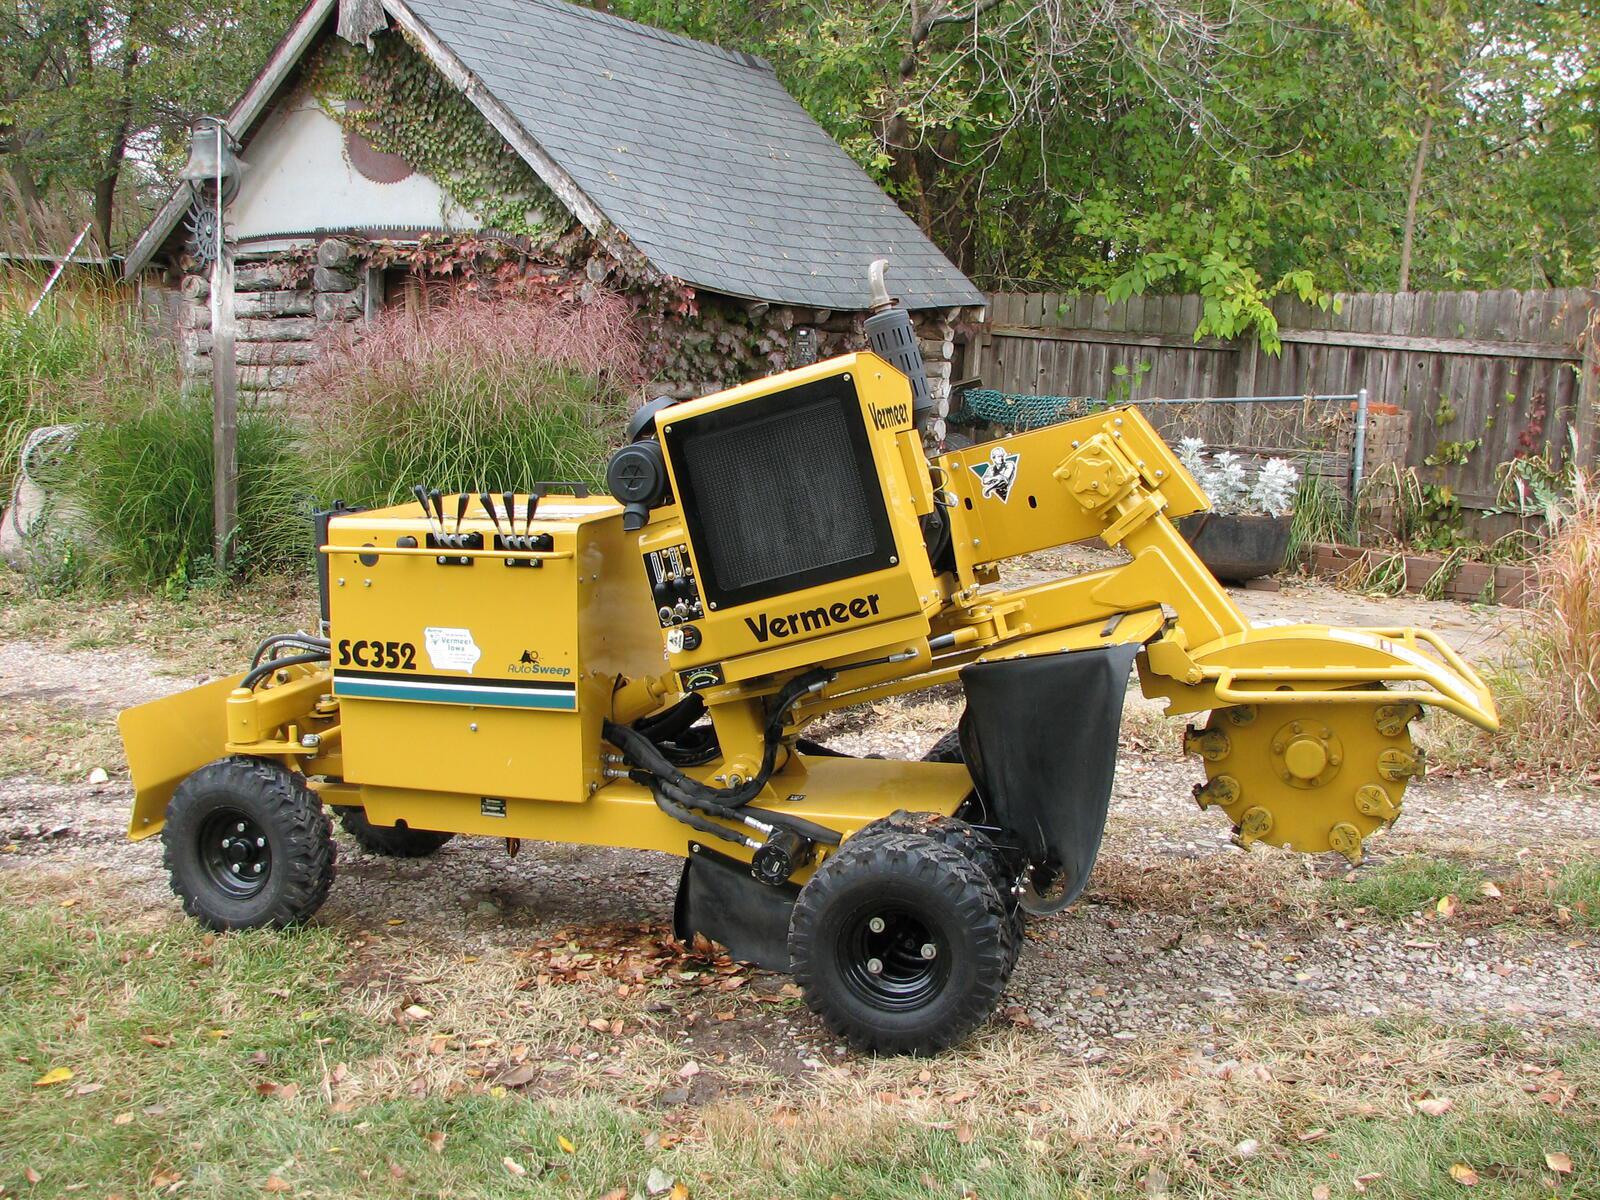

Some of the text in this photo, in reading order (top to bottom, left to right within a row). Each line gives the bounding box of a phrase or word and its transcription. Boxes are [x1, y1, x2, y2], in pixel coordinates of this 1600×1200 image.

[867, 402, 910, 431] Vermeer
[744, 593, 880, 643] Vermeer
[338, 639, 417, 670] SC352
[441, 637, 472, 646] Vermeer
[507, 663, 571, 677] AutoSweep
